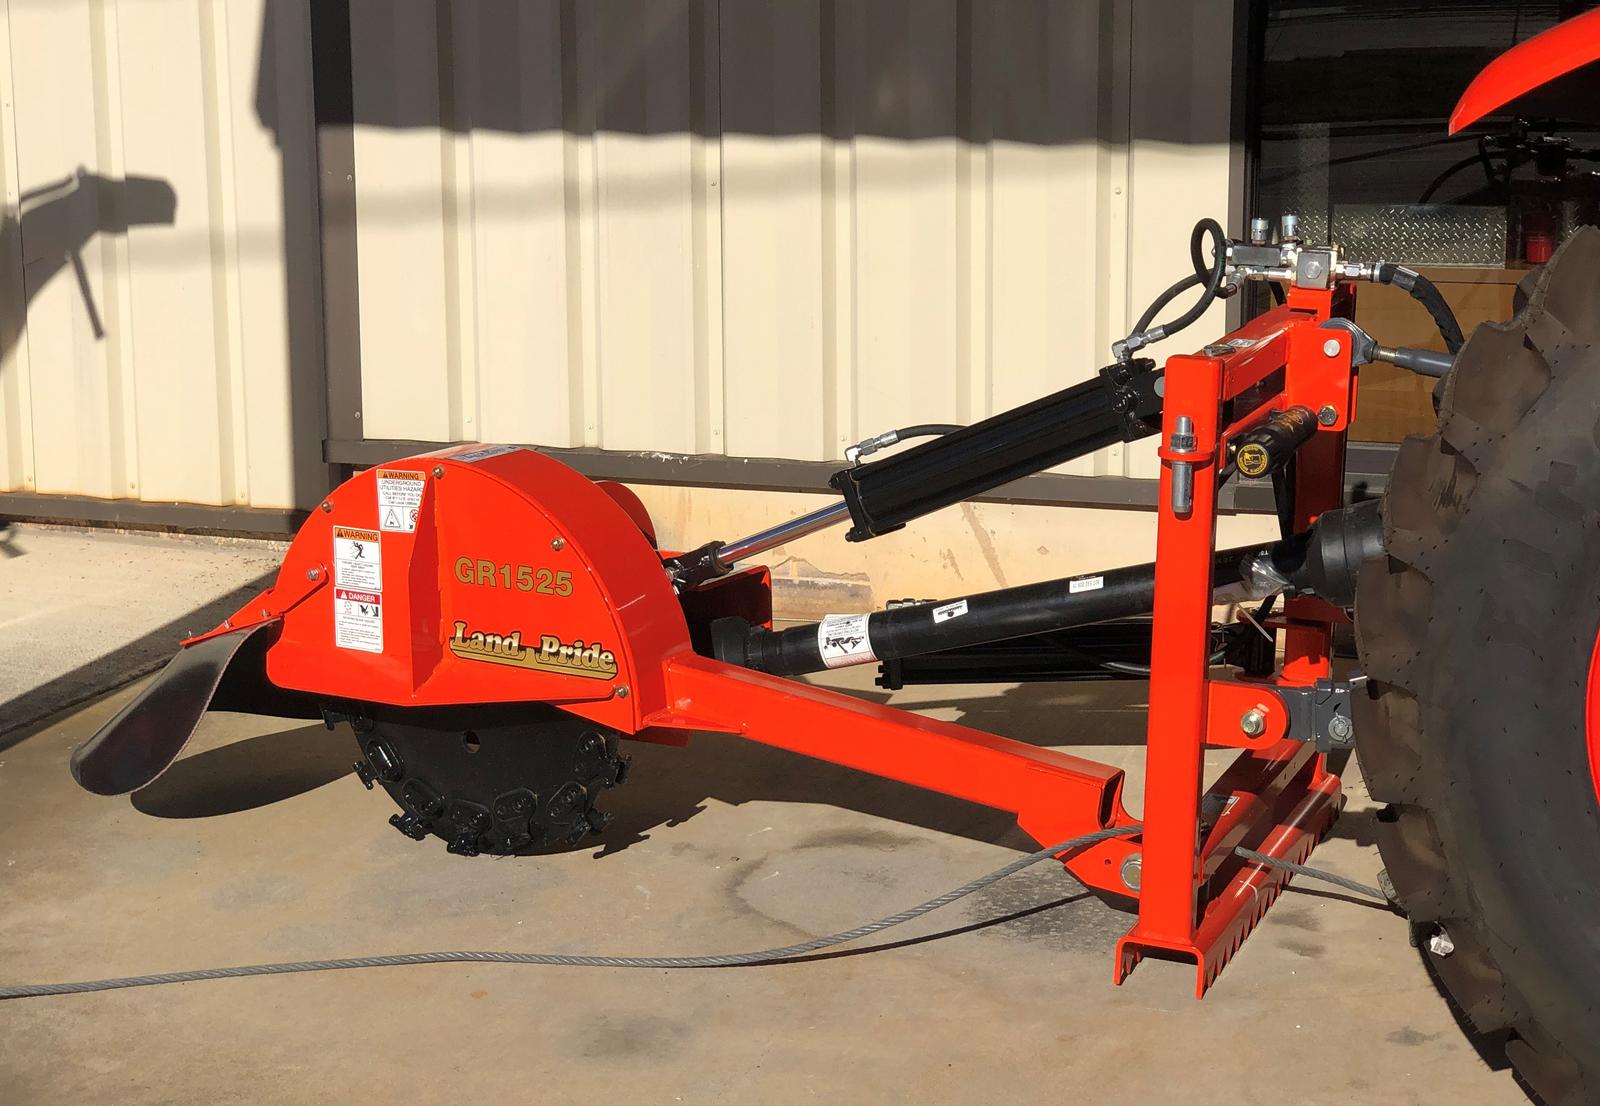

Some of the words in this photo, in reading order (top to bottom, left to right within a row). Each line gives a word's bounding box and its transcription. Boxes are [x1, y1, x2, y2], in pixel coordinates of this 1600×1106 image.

[387, 472, 419, 480] WARNING
[343, 529, 379, 541] WARNING
[454, 556, 573, 597] GR1525
[348, 592, 376, 603] DANGER
[451, 621, 522, 657] Land
[540, 634, 617, 670] Pride
